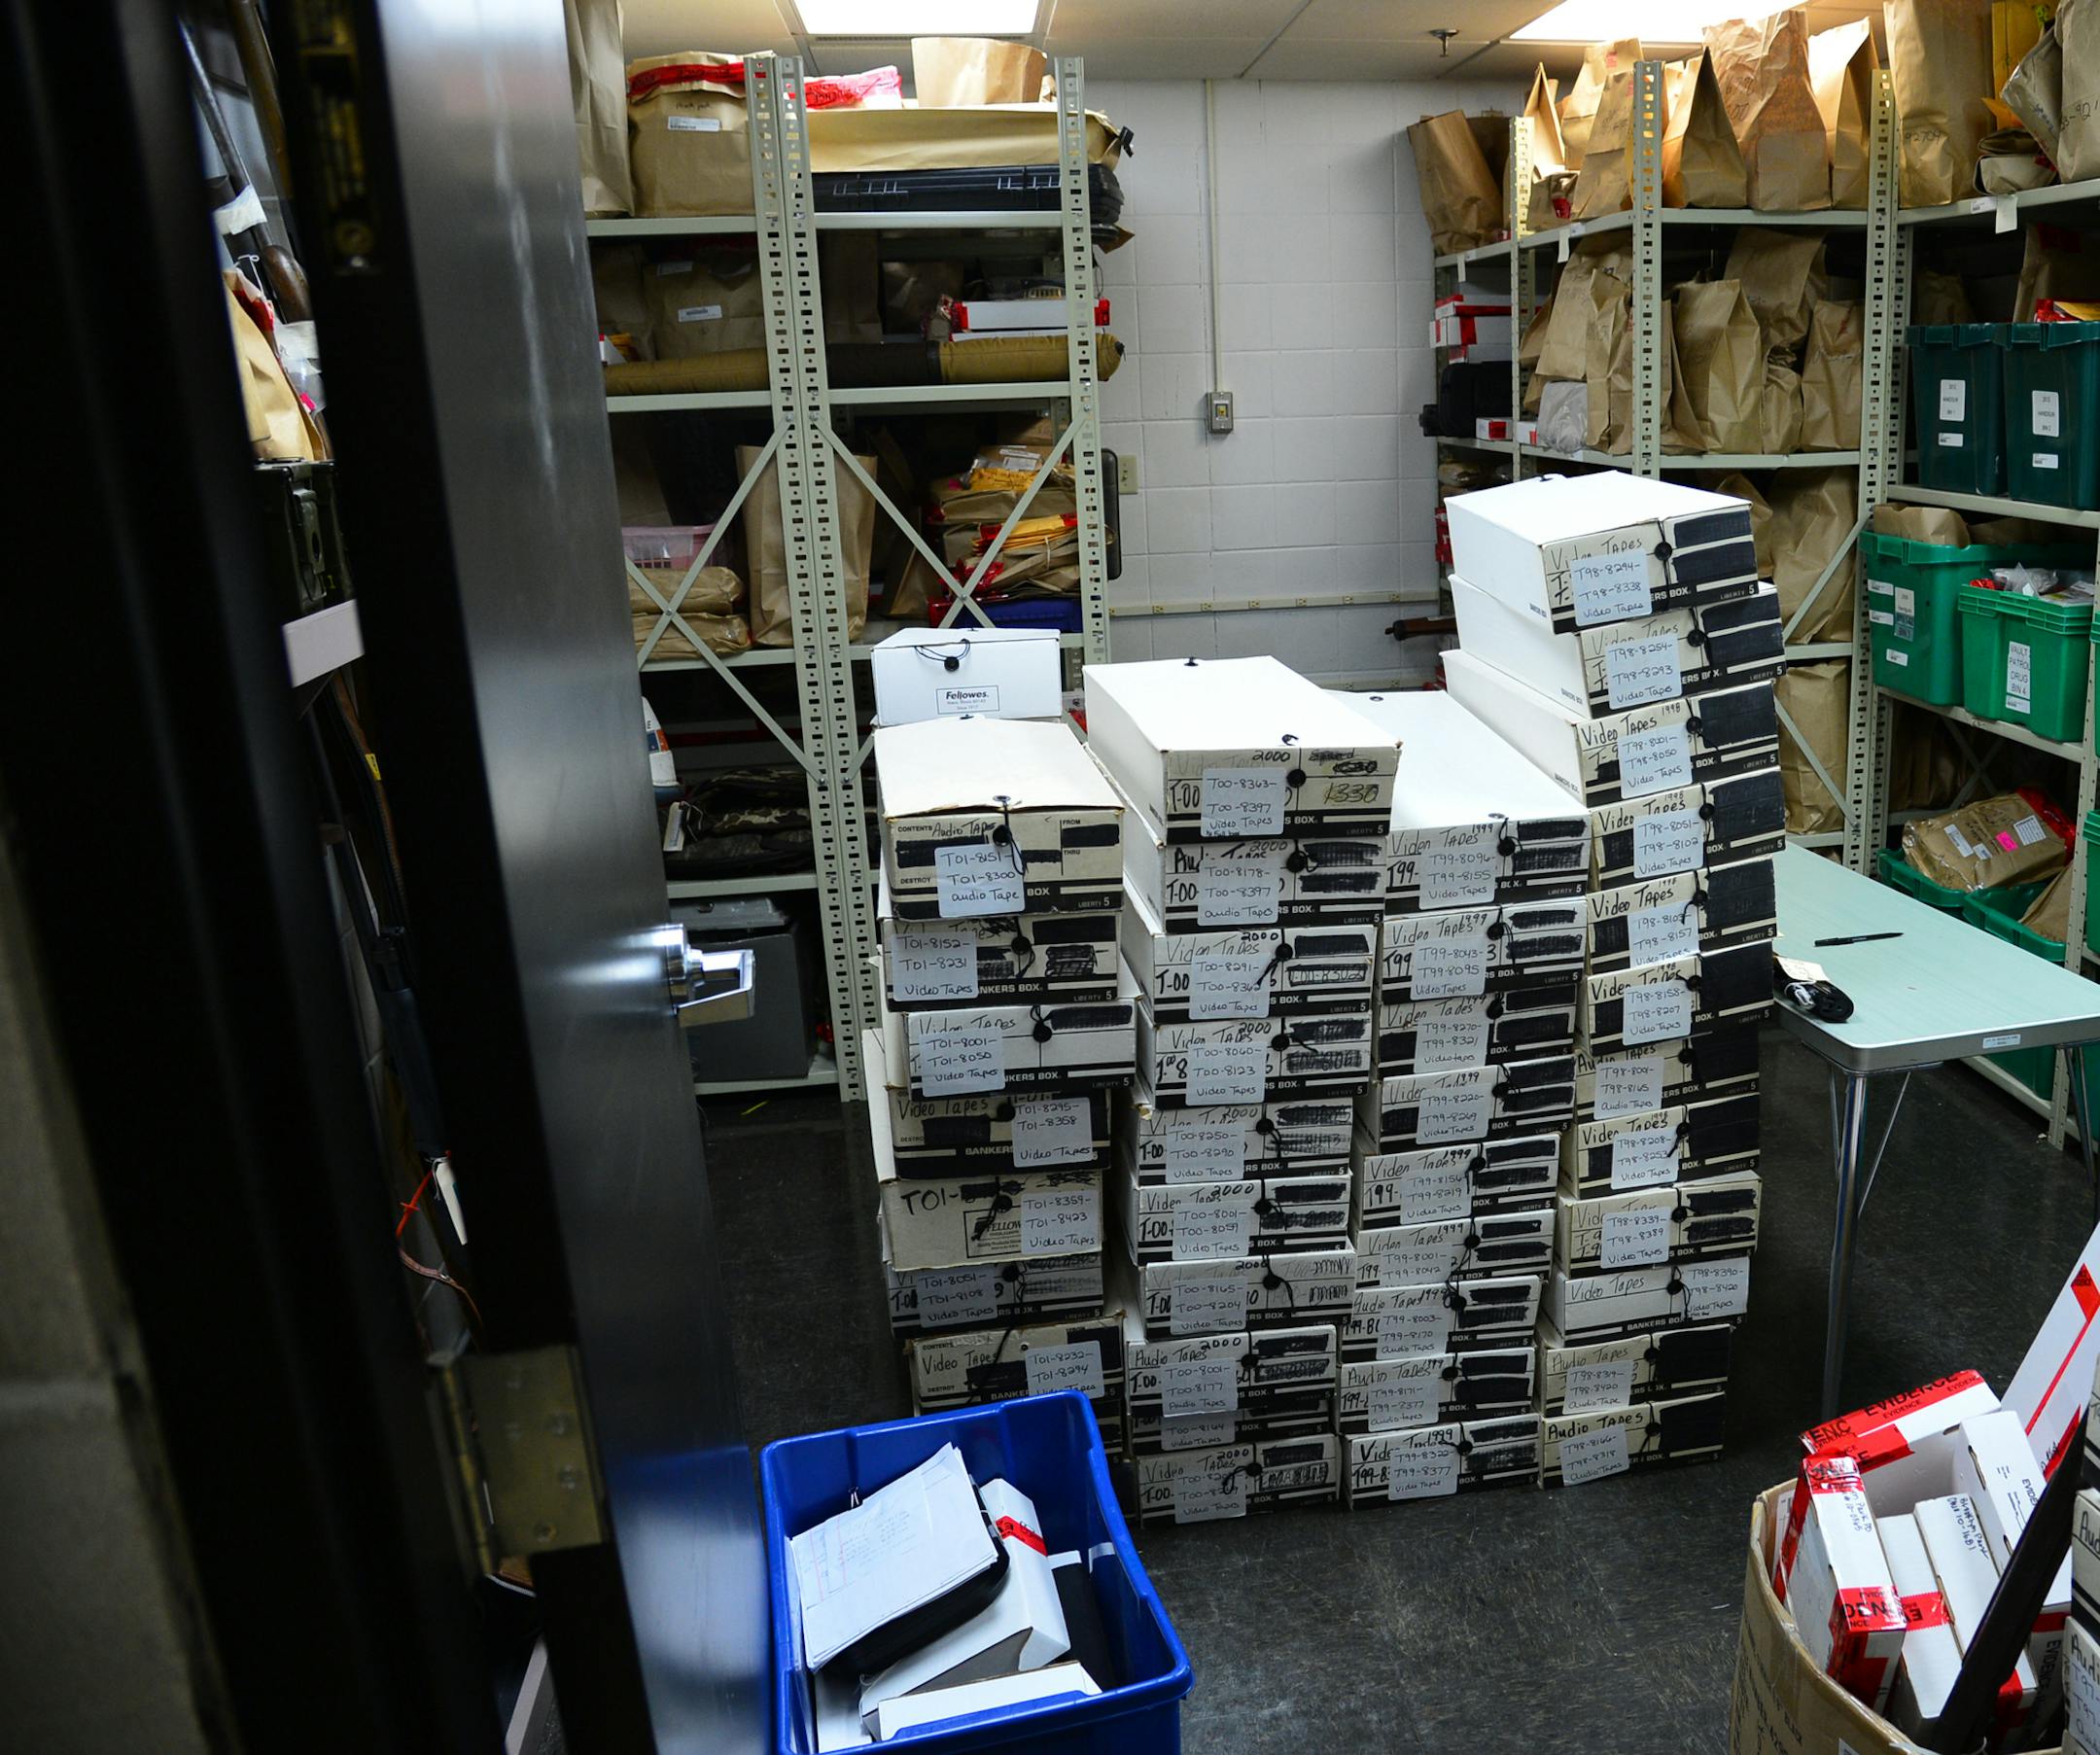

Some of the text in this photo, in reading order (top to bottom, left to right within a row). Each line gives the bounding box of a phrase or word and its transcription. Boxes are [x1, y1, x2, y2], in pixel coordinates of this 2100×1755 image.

[1669, 586, 1689, 598] BOX
[1721, 584, 1754, 600] LIBERTY 5
[2011, 671, 2028, 683] DRUG
[2012, 684, 2022, 693] BIN
[1662, 703, 1681, 716] 1998
[1252, 751, 1290, 761] 2000
[1770, 754, 1775, 762] 5
[1696, 758, 1715, 767] BOX
[932, 824, 962, 836] Audio
[1472, 824, 1492, 833] 1999
[1249, 841, 1287, 852] 2000
[1707, 844, 1723, 854] BOX
[1461, 914, 1487, 926] 1999
[1241, 932, 1278, 941] 2000
[1742, 932, 1765, 941] LIBERTY
[1277, 996, 1300, 1004] BOX
[1696, 1013, 1712, 1022] BOX
[1240, 1022, 1272, 1034] 2000
[1038, 1071, 1059, 1080] BOX
[1124, 1077, 1129, 1086] 5
[898, 1101, 936, 1120] Video
[1443, 1150, 1471, 1160] 1999
[1682, 1161, 1698, 1170] BOX
[1210, 1183, 1254, 1196] 2000
[1437, 1223, 1463, 1234] 1999
[1256, 1239, 1276, 1247] BOX
[1572, 1276, 1644, 1300] Video Tapes
[1201, 1338, 1241, 1350] 2000
[1553, 1347, 1628, 1370] Audio Tapes
[922, 1356, 958, 1374] Video
[1947, 1375, 1979, 1392] EVIDENC
[1427, 1428, 1452, 1440] 1999
